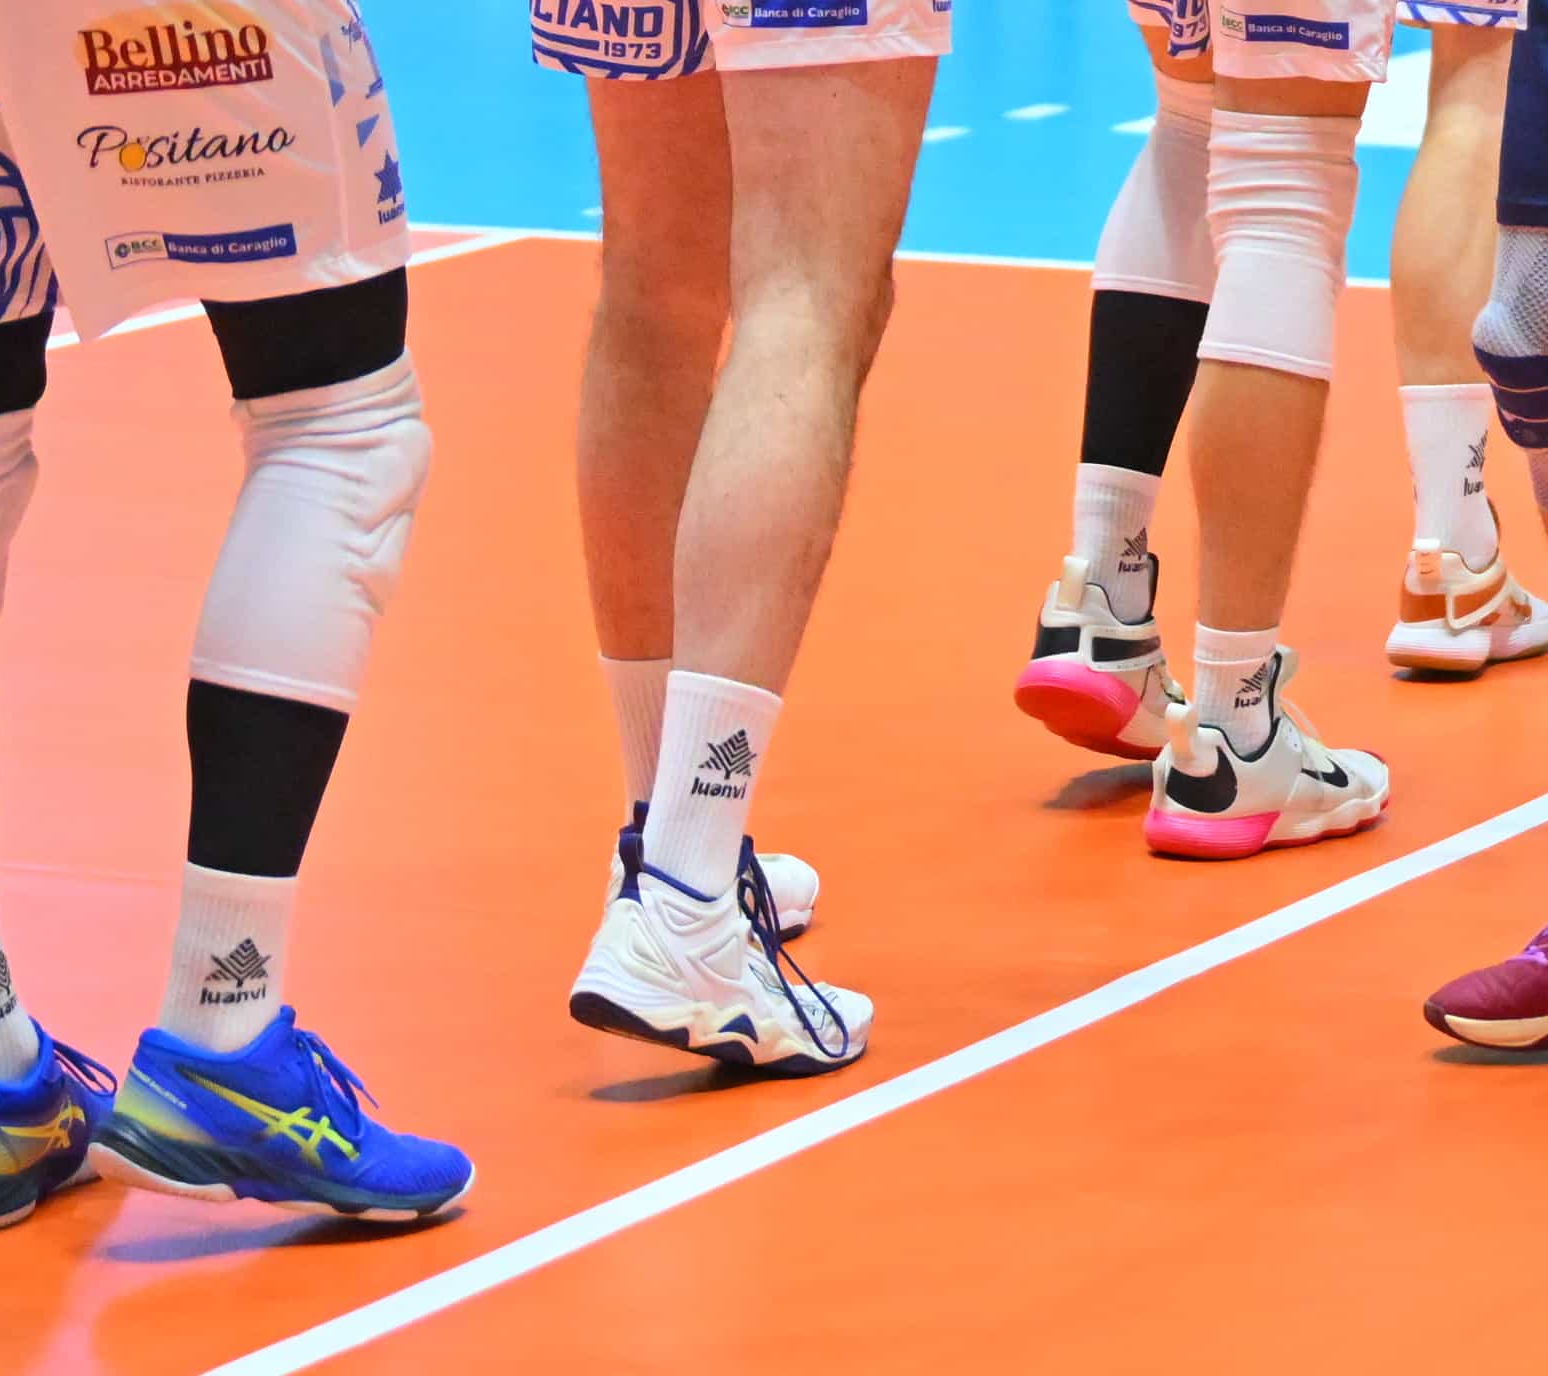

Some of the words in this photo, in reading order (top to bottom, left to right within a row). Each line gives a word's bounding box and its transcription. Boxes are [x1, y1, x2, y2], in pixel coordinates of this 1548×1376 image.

[753, 6, 789, 19] Banca
[792, 5, 805, 19] di
[808, 3, 861, 22] Caraglio
[1248, 21, 1283, 34] Banca
[1285, 23, 1297, 36] di
[1299, 24, 1344, 43] Caraglio
[76, 19, 268, 70] Bellino
[603, 40, 662, 60] 1973
[91, 58, 270, 92] ARREDAMENTI
[120, 174, 201, 186] RISTORANTE
[204, 167, 266, 182] PIZZERIA
[168, 240, 208, 255] Banca
[211, 237, 224, 253] di
[228, 233, 288, 256] Caraglio
[691, 776, 746, 801] luanvi
[199, 986, 267, 1006] luanvi
